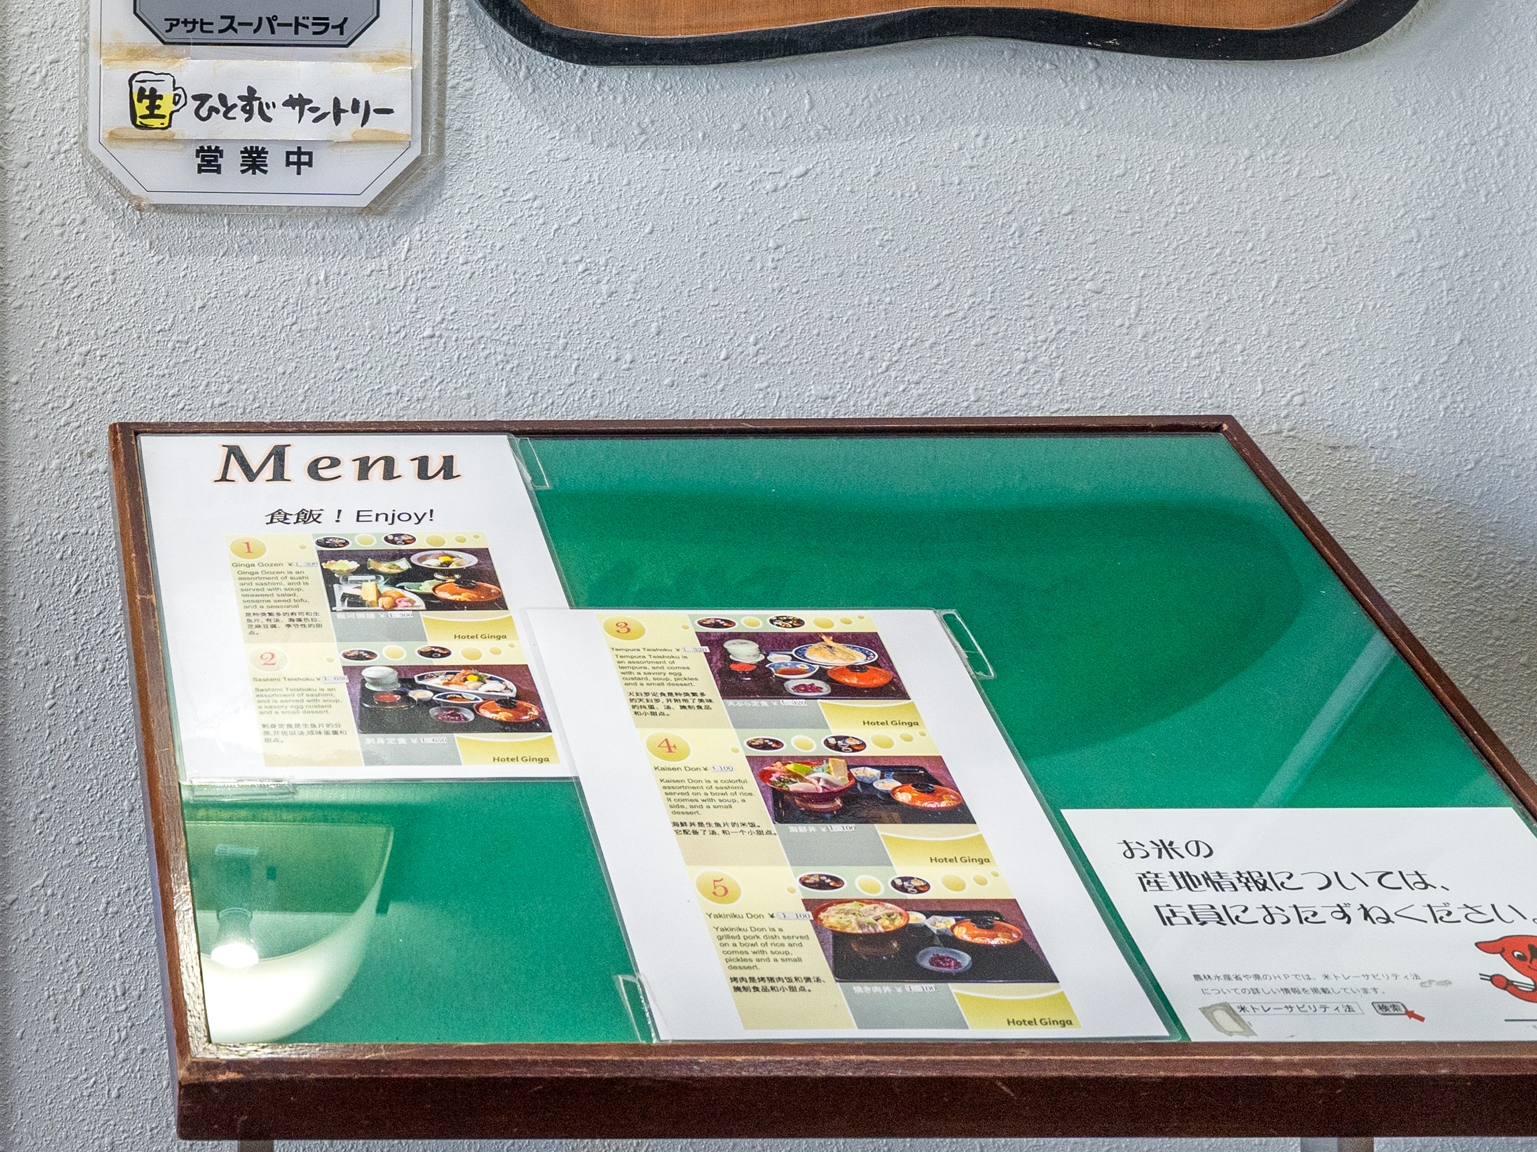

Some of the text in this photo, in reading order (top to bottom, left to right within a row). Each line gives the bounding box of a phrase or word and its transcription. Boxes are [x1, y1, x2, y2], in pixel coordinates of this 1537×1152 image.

[136, 86, 168, 120] 生
[195, 145, 314, 176] 営業中
[213, 444, 462, 484] Menu
[356, 509, 435, 526] Enjoy!
[243, 541, 254, 554] 1
[616, 622, 632, 635] 3
[260, 652, 277, 666] 2
[890, 720, 920, 728] Ginga
[658, 738, 678, 754] 4
[521, 756, 550, 764] Ginga
[1117, 838, 1214, 861] お米の
[930, 856, 991, 865] Hotel Ginga
[712, 878, 729, 898] 5
[1135, 870, 1451, 893] 産地情報については、
[1377, 1004, 1404, 1013] 検索
[1007, 1018, 1074, 1028] Hotel Ginga
